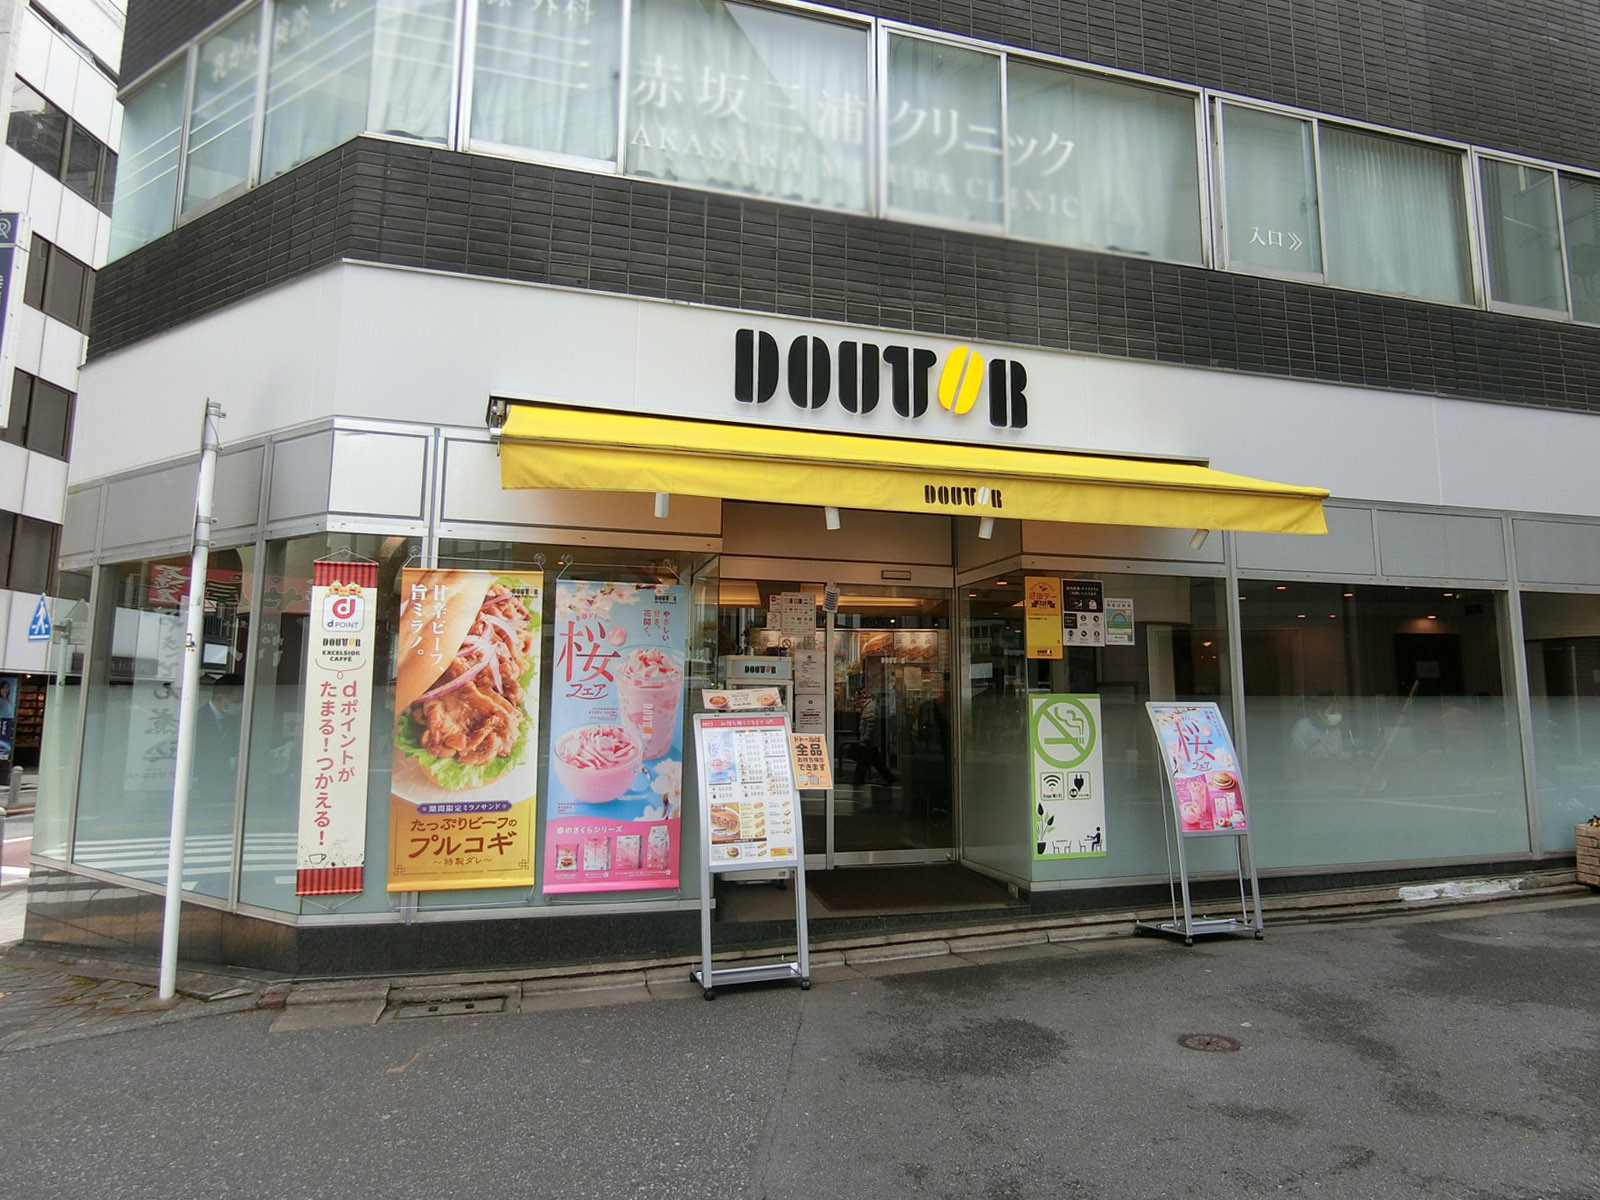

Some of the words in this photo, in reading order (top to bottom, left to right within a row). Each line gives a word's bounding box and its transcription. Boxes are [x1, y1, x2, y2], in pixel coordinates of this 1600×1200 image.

[630, 122, 801, 173] AKASAKA
[1248, 227, 1282, 247] 入口
[734, 328, 1029, 429] DOUTOR
[925, 485, 1003, 508] DOUTOR
[411, 583, 428, 655] 旨ミラノ。
[322, 637, 361, 647] DOUTOR
[556, 620, 622, 683] 桜
[744, 665, 777, 674] DOUTOR
[566, 683, 609, 700] フェア
[338, 680, 358, 783] dポイントが
[1173, 721, 1216, 762] 桜
[795, 743, 823, 756] 全品
[429, 803, 502, 812] 期間限定ミラノサンド
[410, 816, 518, 832] たっぷりビーフの
[556, 825, 624, 835] 春のさくらシリーズ
[409, 831, 517, 858] プルコギ
